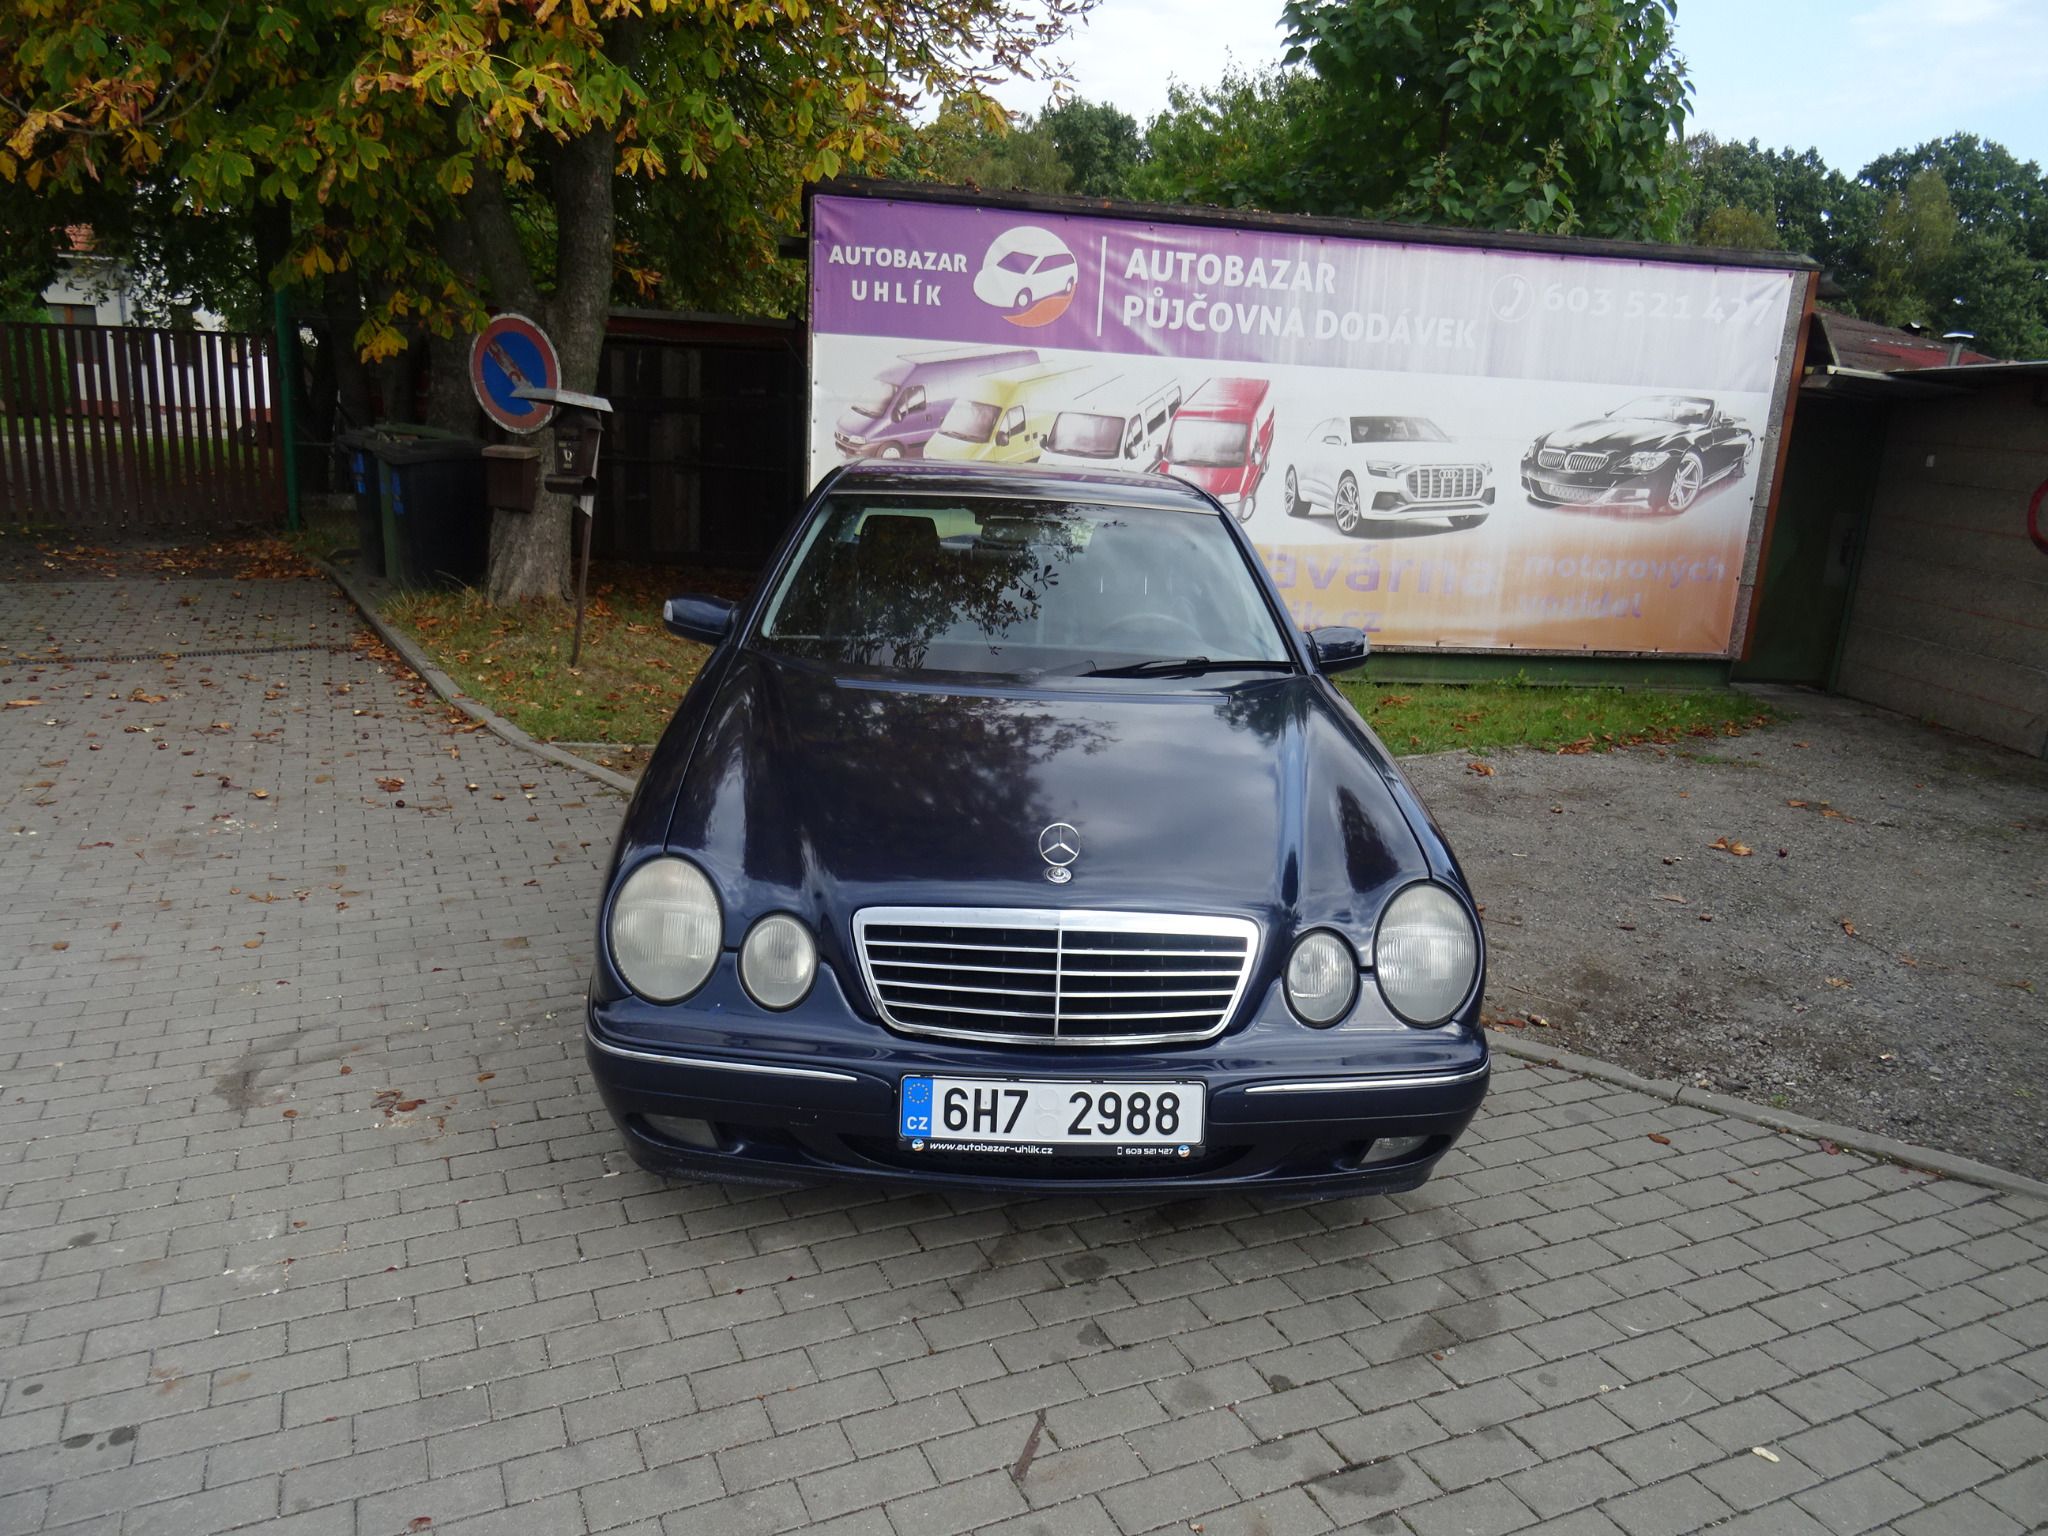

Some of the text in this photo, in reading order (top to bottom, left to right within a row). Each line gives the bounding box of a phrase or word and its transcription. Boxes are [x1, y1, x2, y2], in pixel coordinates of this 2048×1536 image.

[828, 244, 968, 274] AUTOBAZAR
[1124, 247, 1337, 296] AUTOBAZAR
[851, 279, 942, 306] UHLÍK
[1543, 283, 1775, 327] 603 521 427
[1122, 286, 1477, 351] PŮJČOVNA DODÁVEK
[1266, 544, 1492, 597] avárna
[906, 1116, 929, 1131] CZ
[943, 1086, 1181, 1136] 6H7 2988
[929, 1141, 1053, 1155] www.autobazar-uhlik.cz
[1125, 1147, 1143, 1155] 603
[1143, 1147, 1157, 1155] 521
